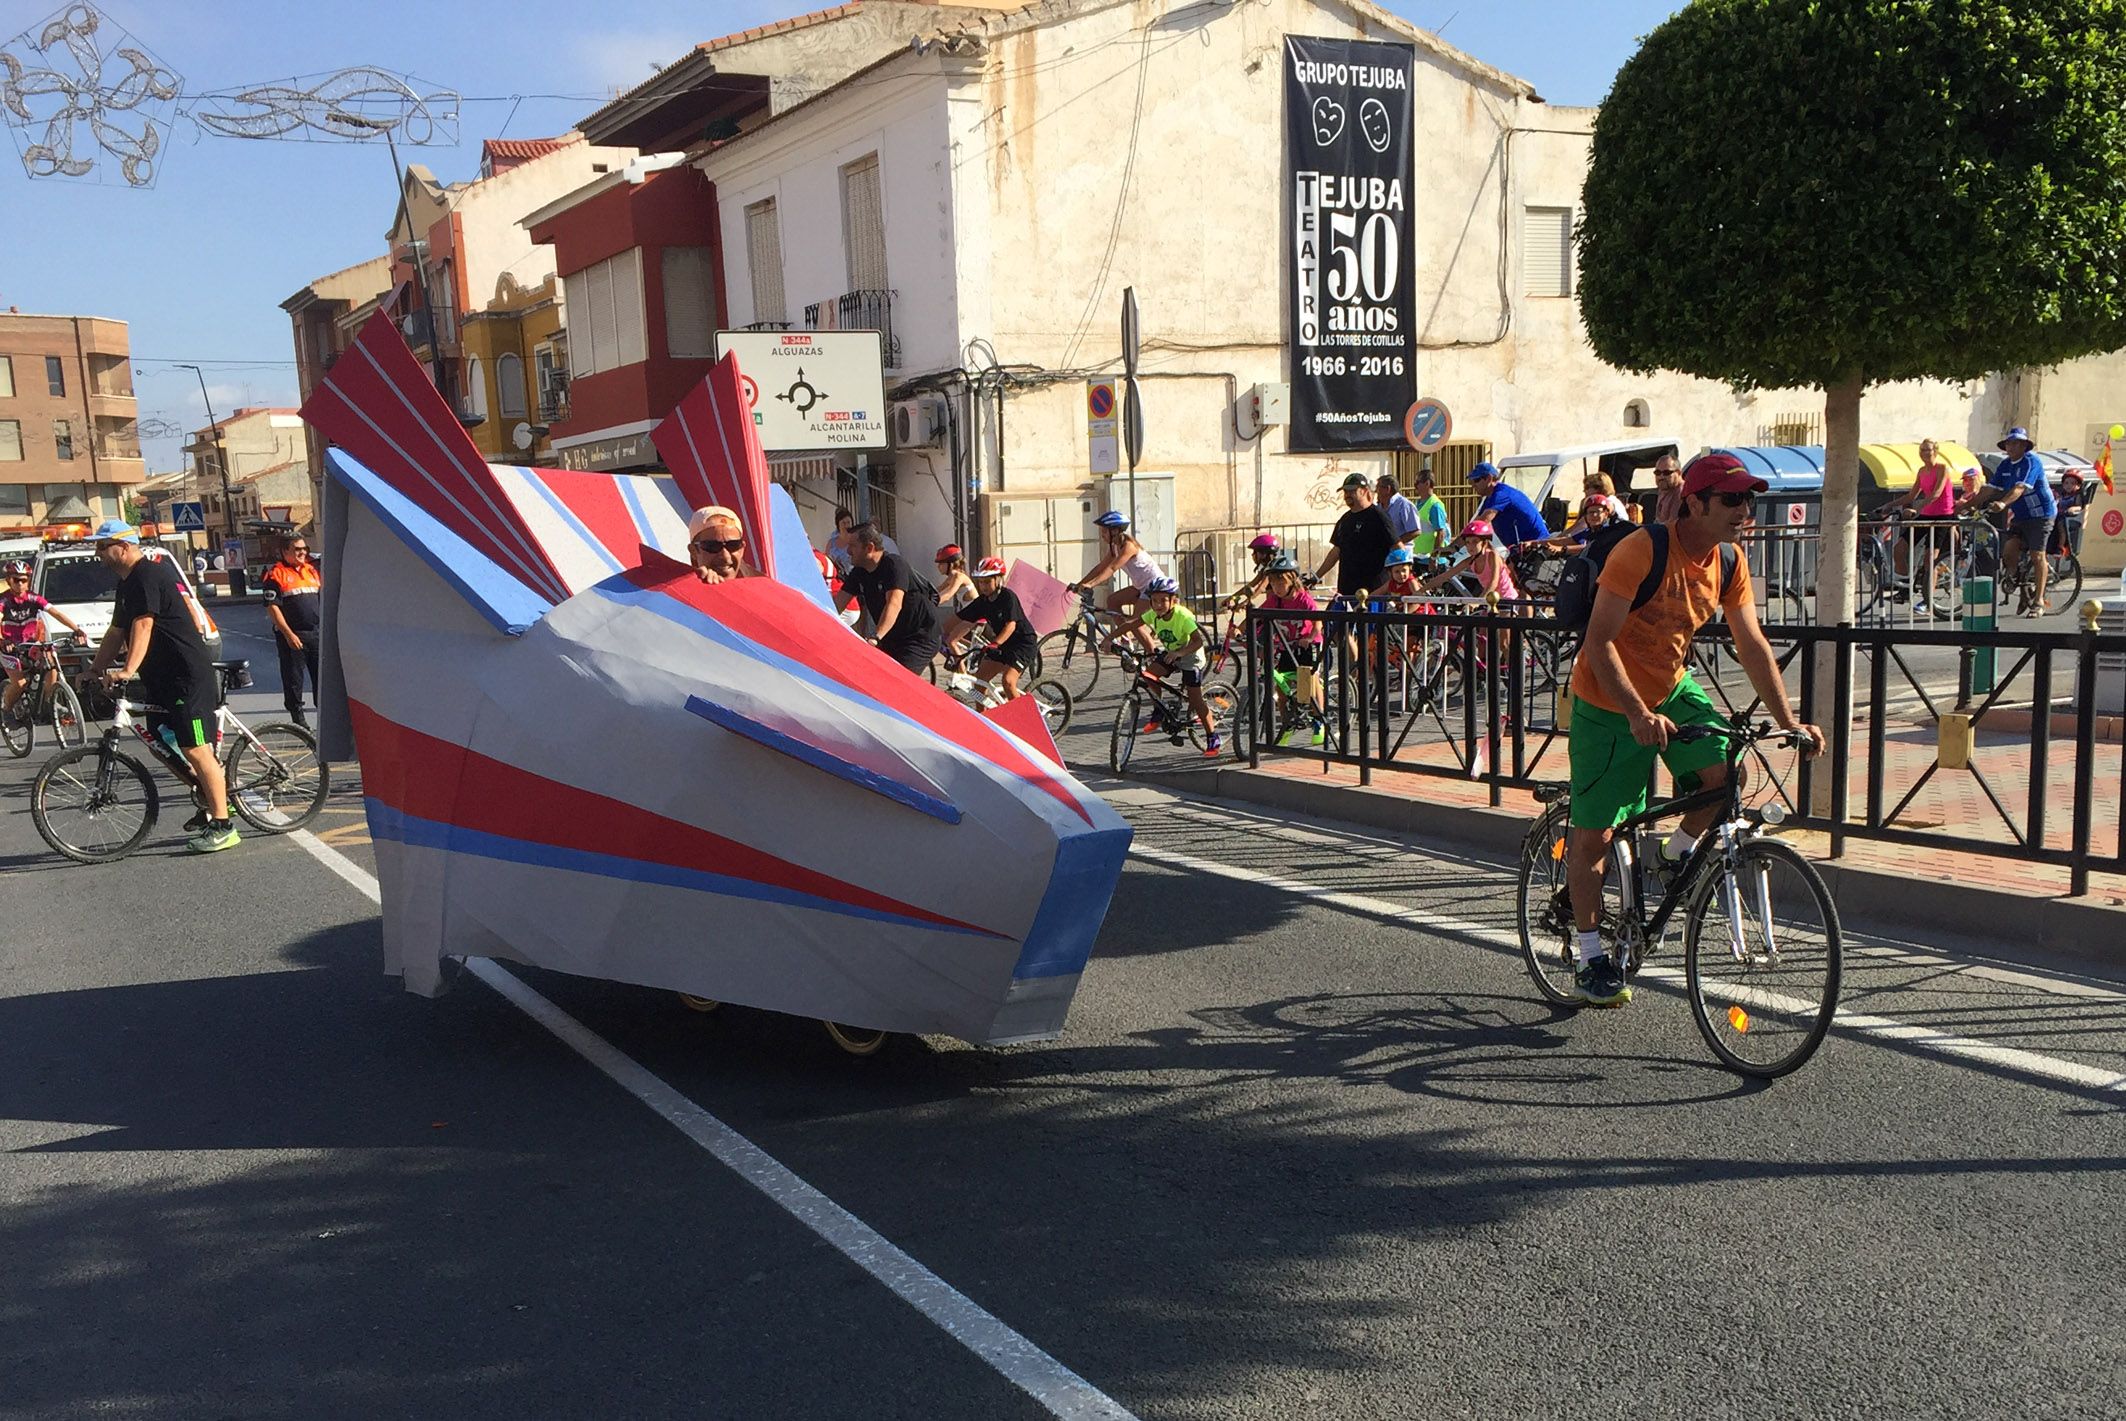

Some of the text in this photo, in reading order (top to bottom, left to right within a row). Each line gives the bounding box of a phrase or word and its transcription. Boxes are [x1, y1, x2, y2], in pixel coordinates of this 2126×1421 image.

[1295, 61, 1406, 89] GRUPO TEJUBA
[1327, 212, 1398, 302] 50
[1327, 296, 1398, 331] años
[1321, 334, 1405, 346] LAS TORRES DE COTILLAS
[771, 347, 823, 356] ALGUAZAS
[1301, 356, 1346, 375] 1966
[1360, 356, 1404, 375] 2016
[1315, 412, 1392, 424] #50AñosTejuba
[810, 422, 882, 431] ALCANTARILLA
[827, 433, 866, 442] MOLINA
